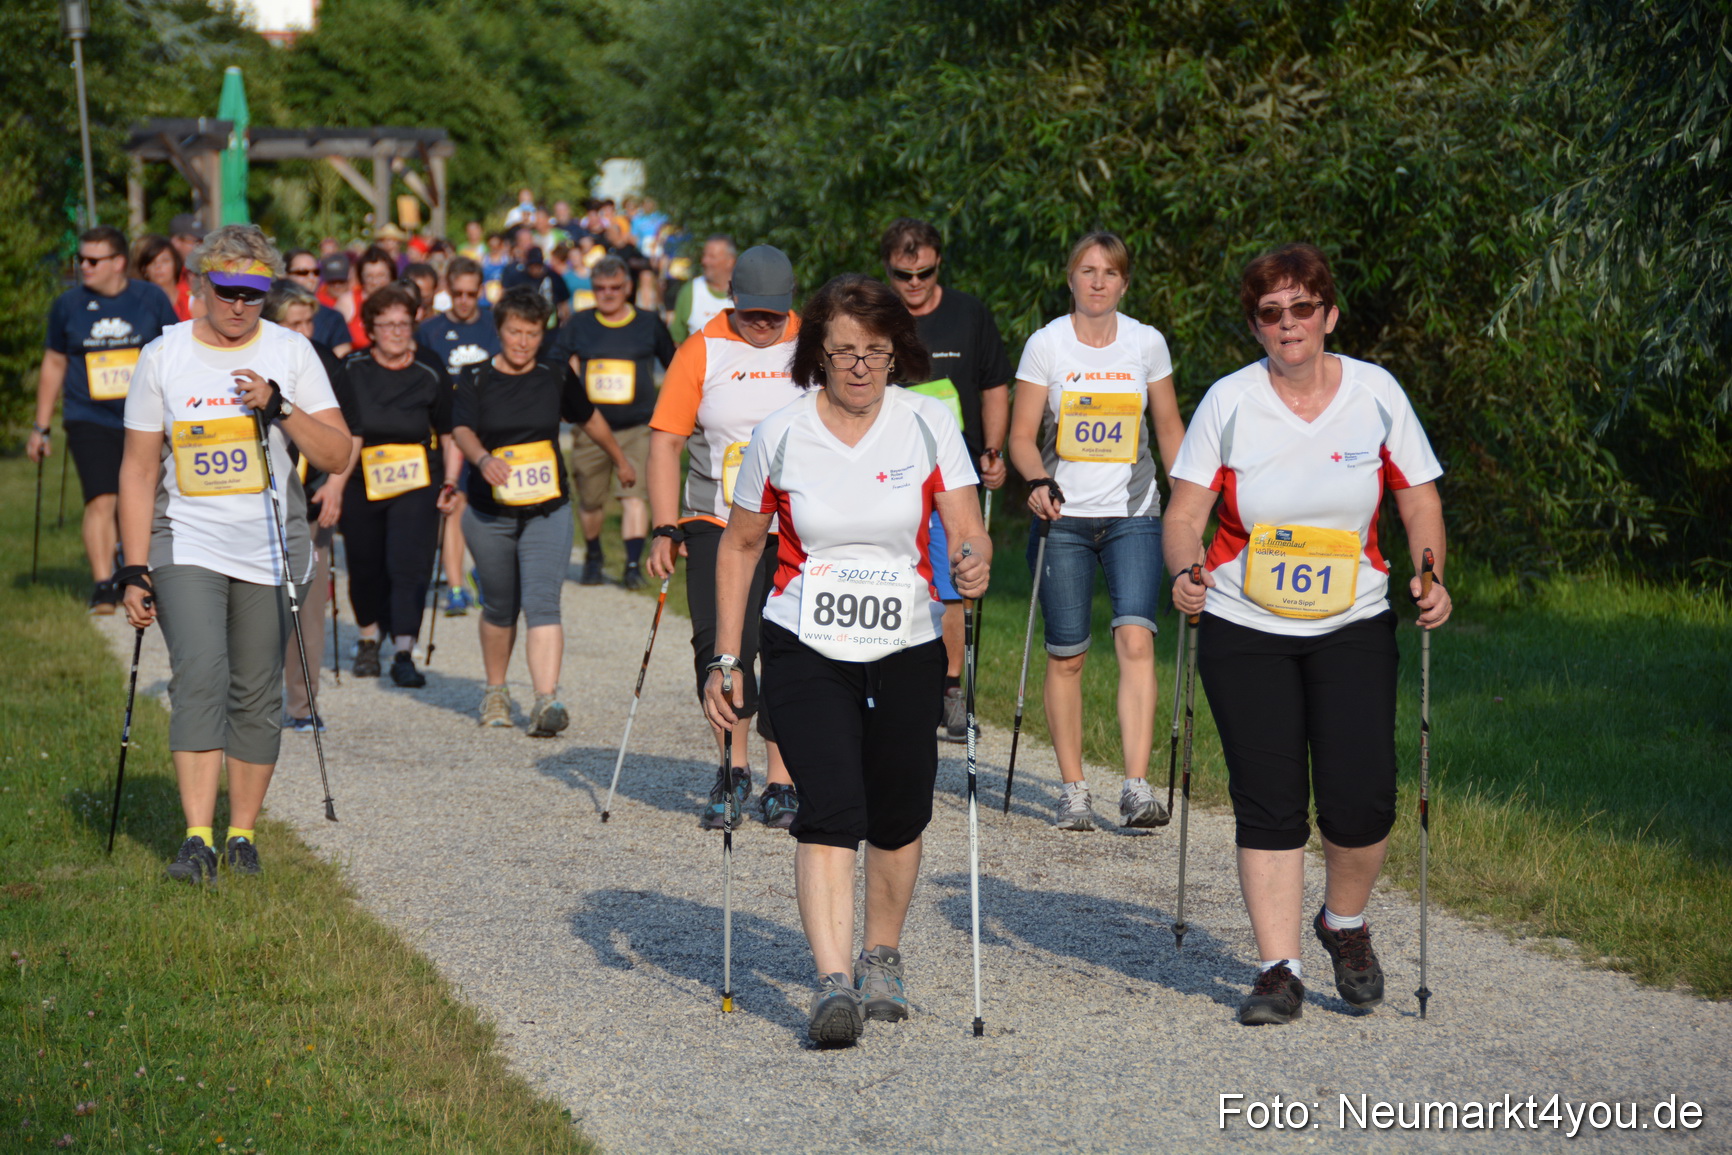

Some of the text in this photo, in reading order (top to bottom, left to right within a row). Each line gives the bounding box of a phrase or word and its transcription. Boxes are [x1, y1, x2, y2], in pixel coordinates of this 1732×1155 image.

[102, 368, 130, 385] 179
[750, 371, 792, 379] KLEB
[1085, 372, 1135, 380] KLEBL
[207, 397, 242, 406] KLE
[1075, 421, 1122, 443] 604
[194, 448, 247, 476] 599
[372, 462, 419, 484] 1247
[504, 466, 550, 488] 186
[1267, 538, 1306, 548] firmenlauf
[809, 564, 899, 581] df-sports
[1270, 562, 1331, 594] 161
[875, 580, 911, 589] Zeitmessung
[813, 591, 902, 631] 8908
[804, 632, 907, 646] www.df-sports.de
[967, 727, 975, 760] NORDIC
